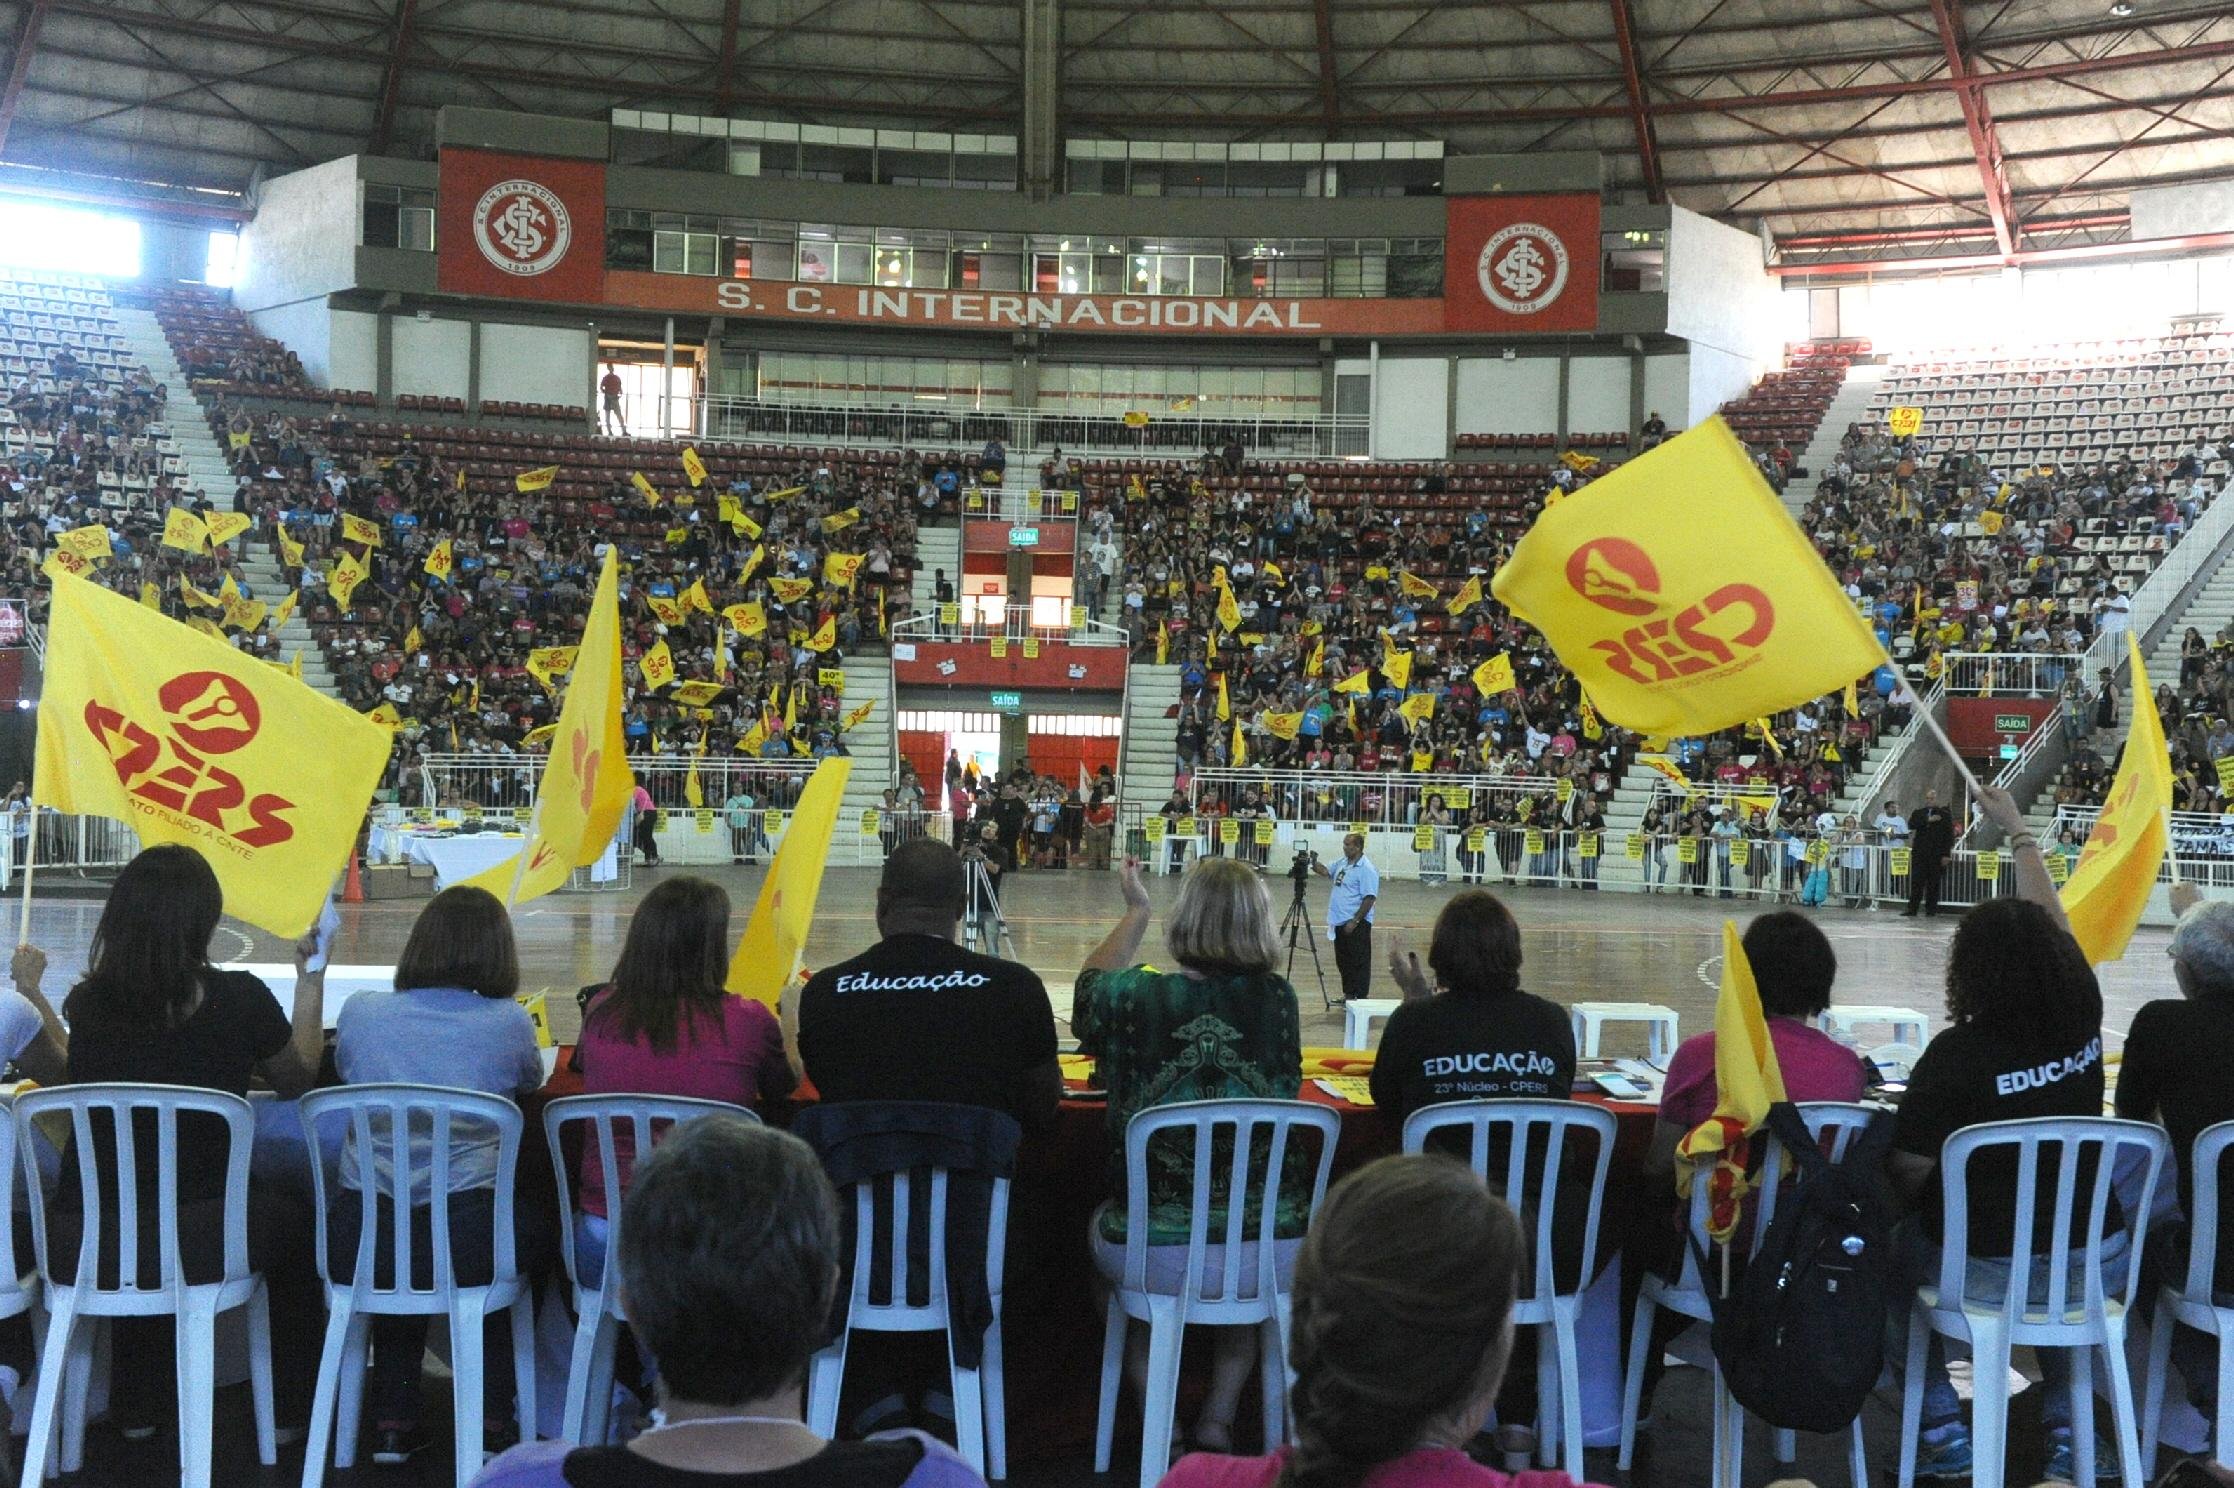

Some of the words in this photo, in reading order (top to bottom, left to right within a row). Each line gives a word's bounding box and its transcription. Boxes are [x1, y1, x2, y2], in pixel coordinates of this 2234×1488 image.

[717, 282, 765, 310] S.
[787, 286, 836, 315] C.
[858, 289, 1321, 329] INTERNACIONAL
[992, 693, 1020, 706] SAÍDA
[1998, 718, 2028, 729] SAÍDA
[836, 970, 991, 993] Educação
[1423, 1050, 1556, 1077] EDUCAÇÃO
[1457, 1081, 1499, 1092] Núcleo
[1509, 1081, 1549, 1094] CPERS
